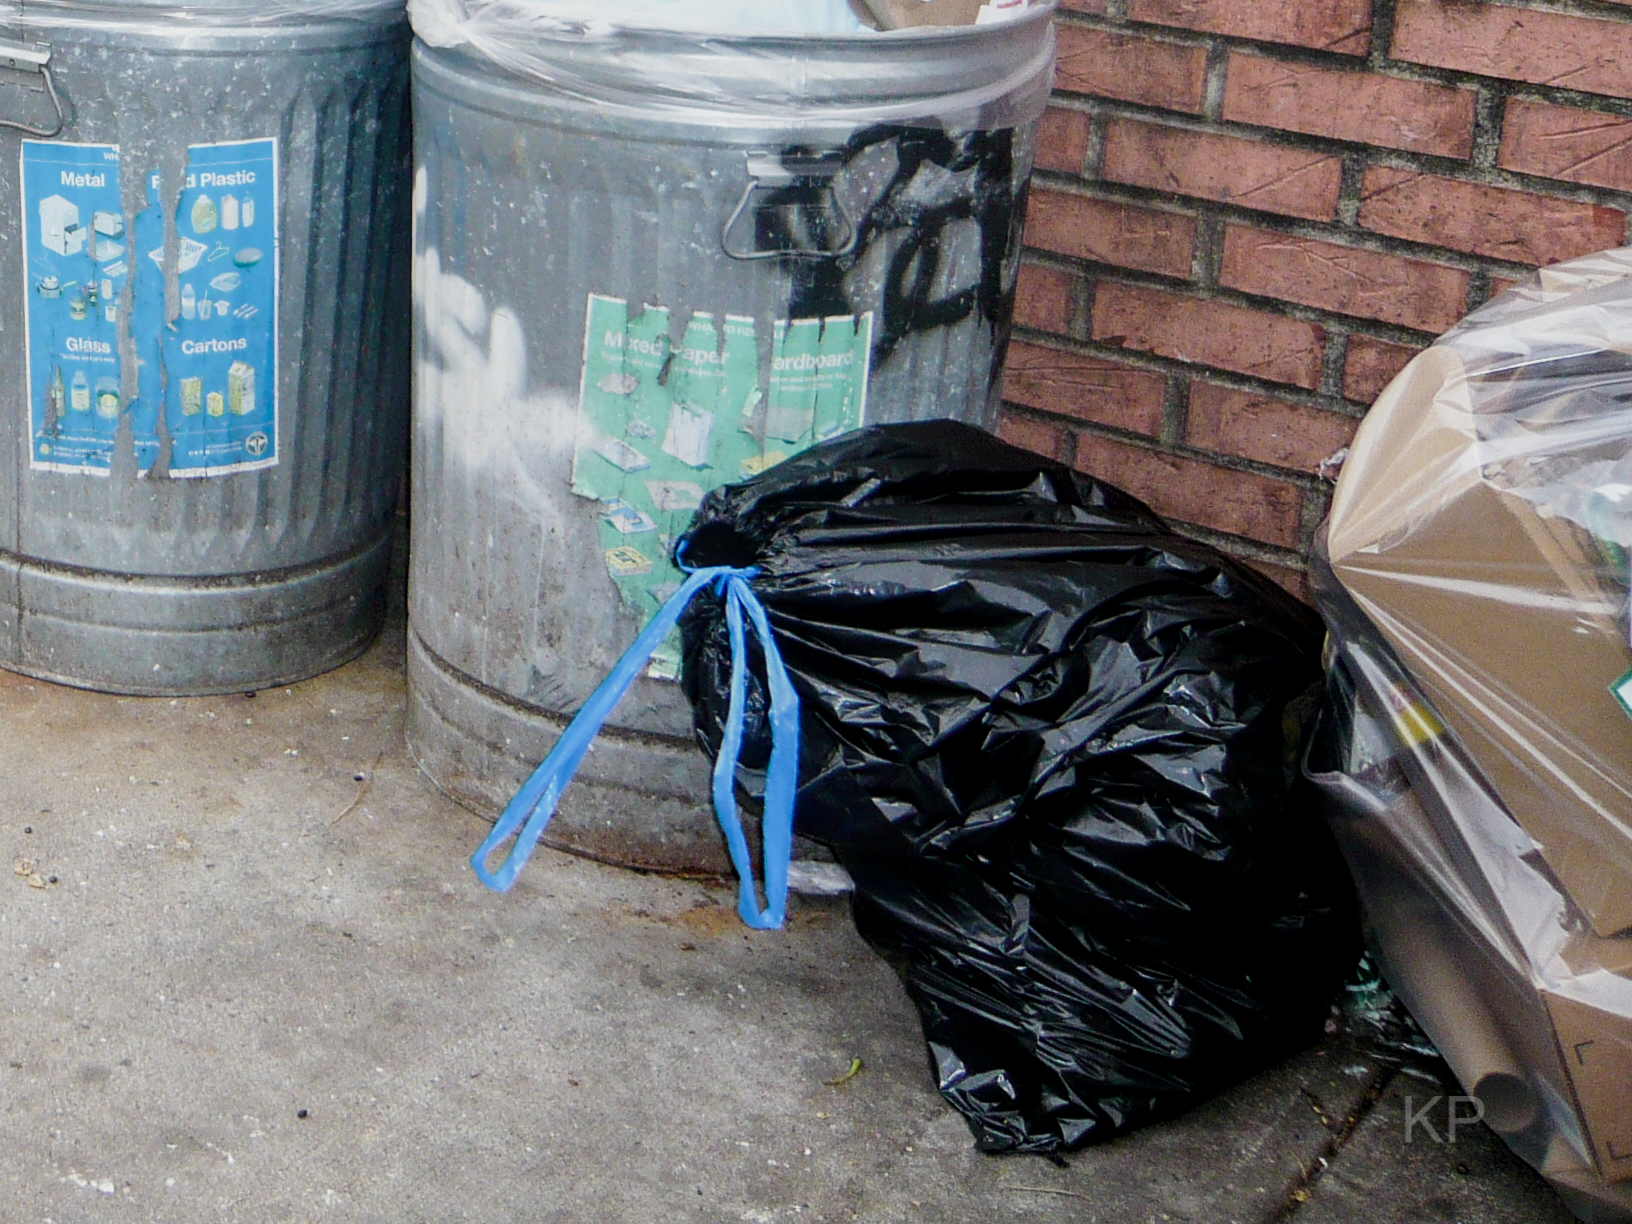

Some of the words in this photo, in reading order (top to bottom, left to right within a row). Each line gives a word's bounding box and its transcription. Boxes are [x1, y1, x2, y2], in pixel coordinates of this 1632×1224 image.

[60, 170, 105, 188] Metal
[200, 169, 256, 188] Plastic
[65, 336, 111, 354] Glass
[181, 337, 248, 354] Cartons
[773, 348, 855, 371] ardboard
